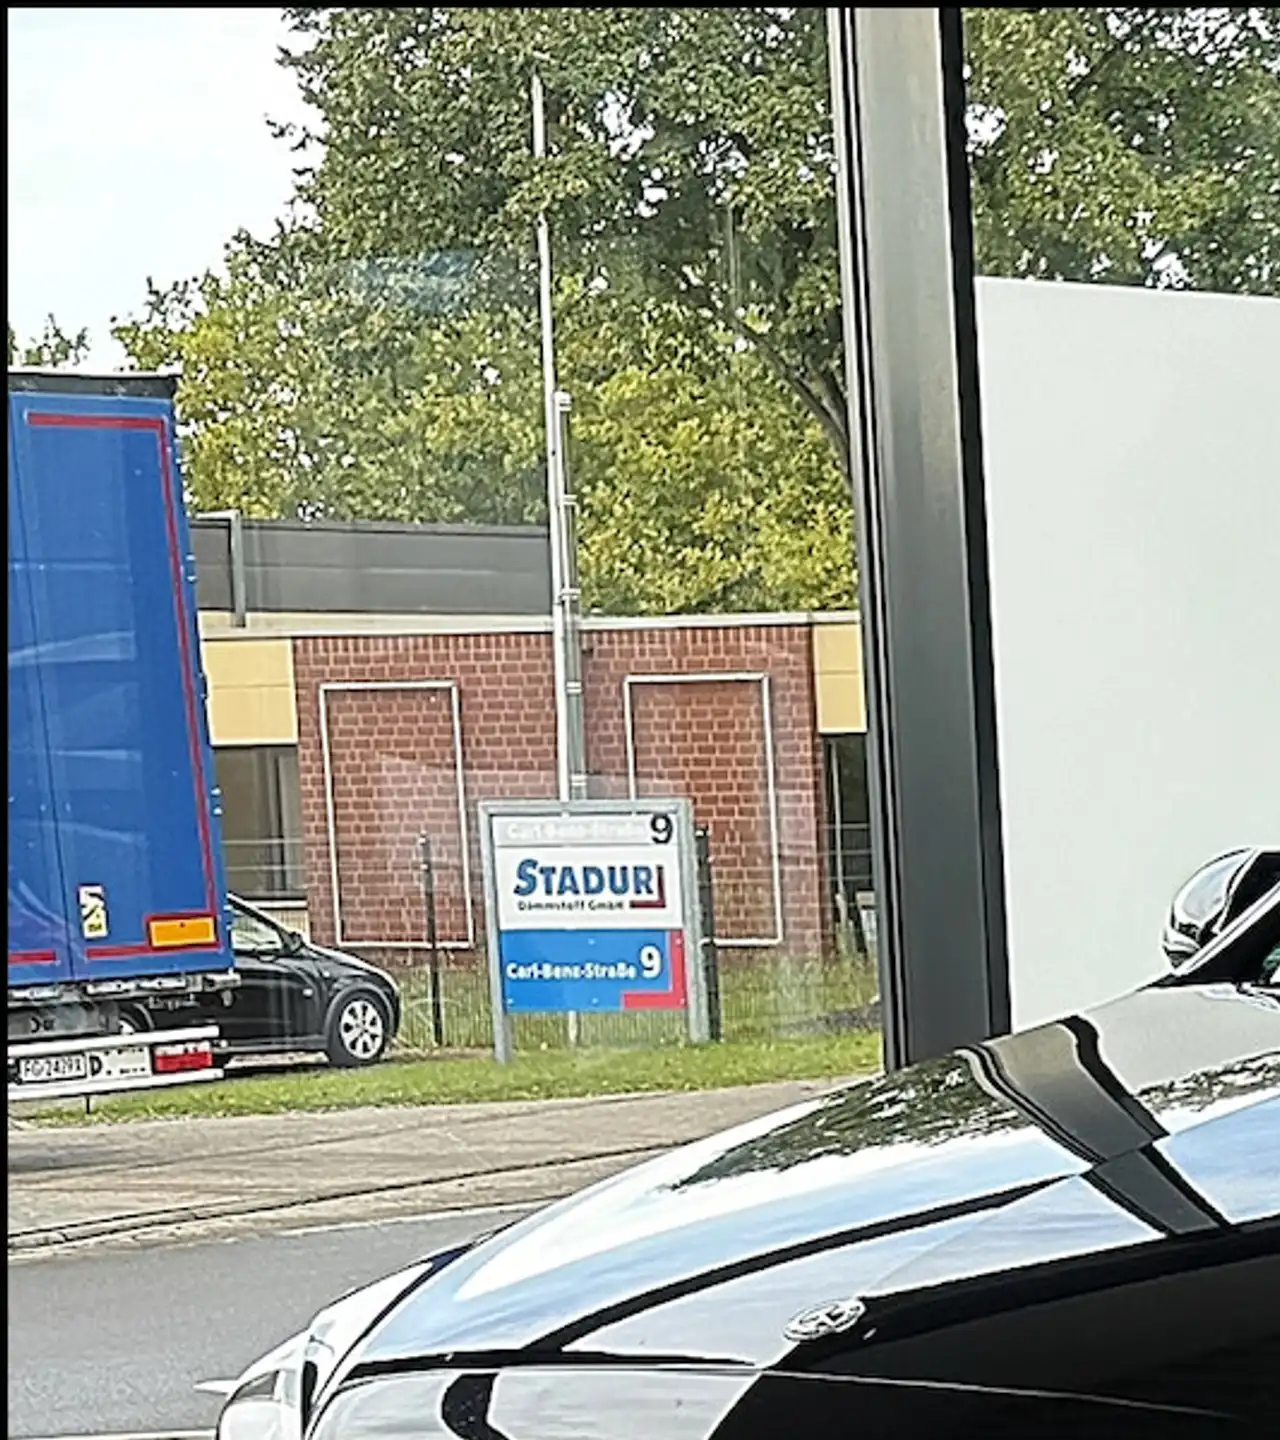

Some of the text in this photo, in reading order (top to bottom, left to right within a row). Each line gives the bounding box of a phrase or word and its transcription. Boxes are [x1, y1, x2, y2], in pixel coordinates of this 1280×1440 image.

[650, 813, 673, 844] 9
[514, 858, 653, 897] STADUR
[506, 944, 662, 981] Carl-Benz-Straße 9
